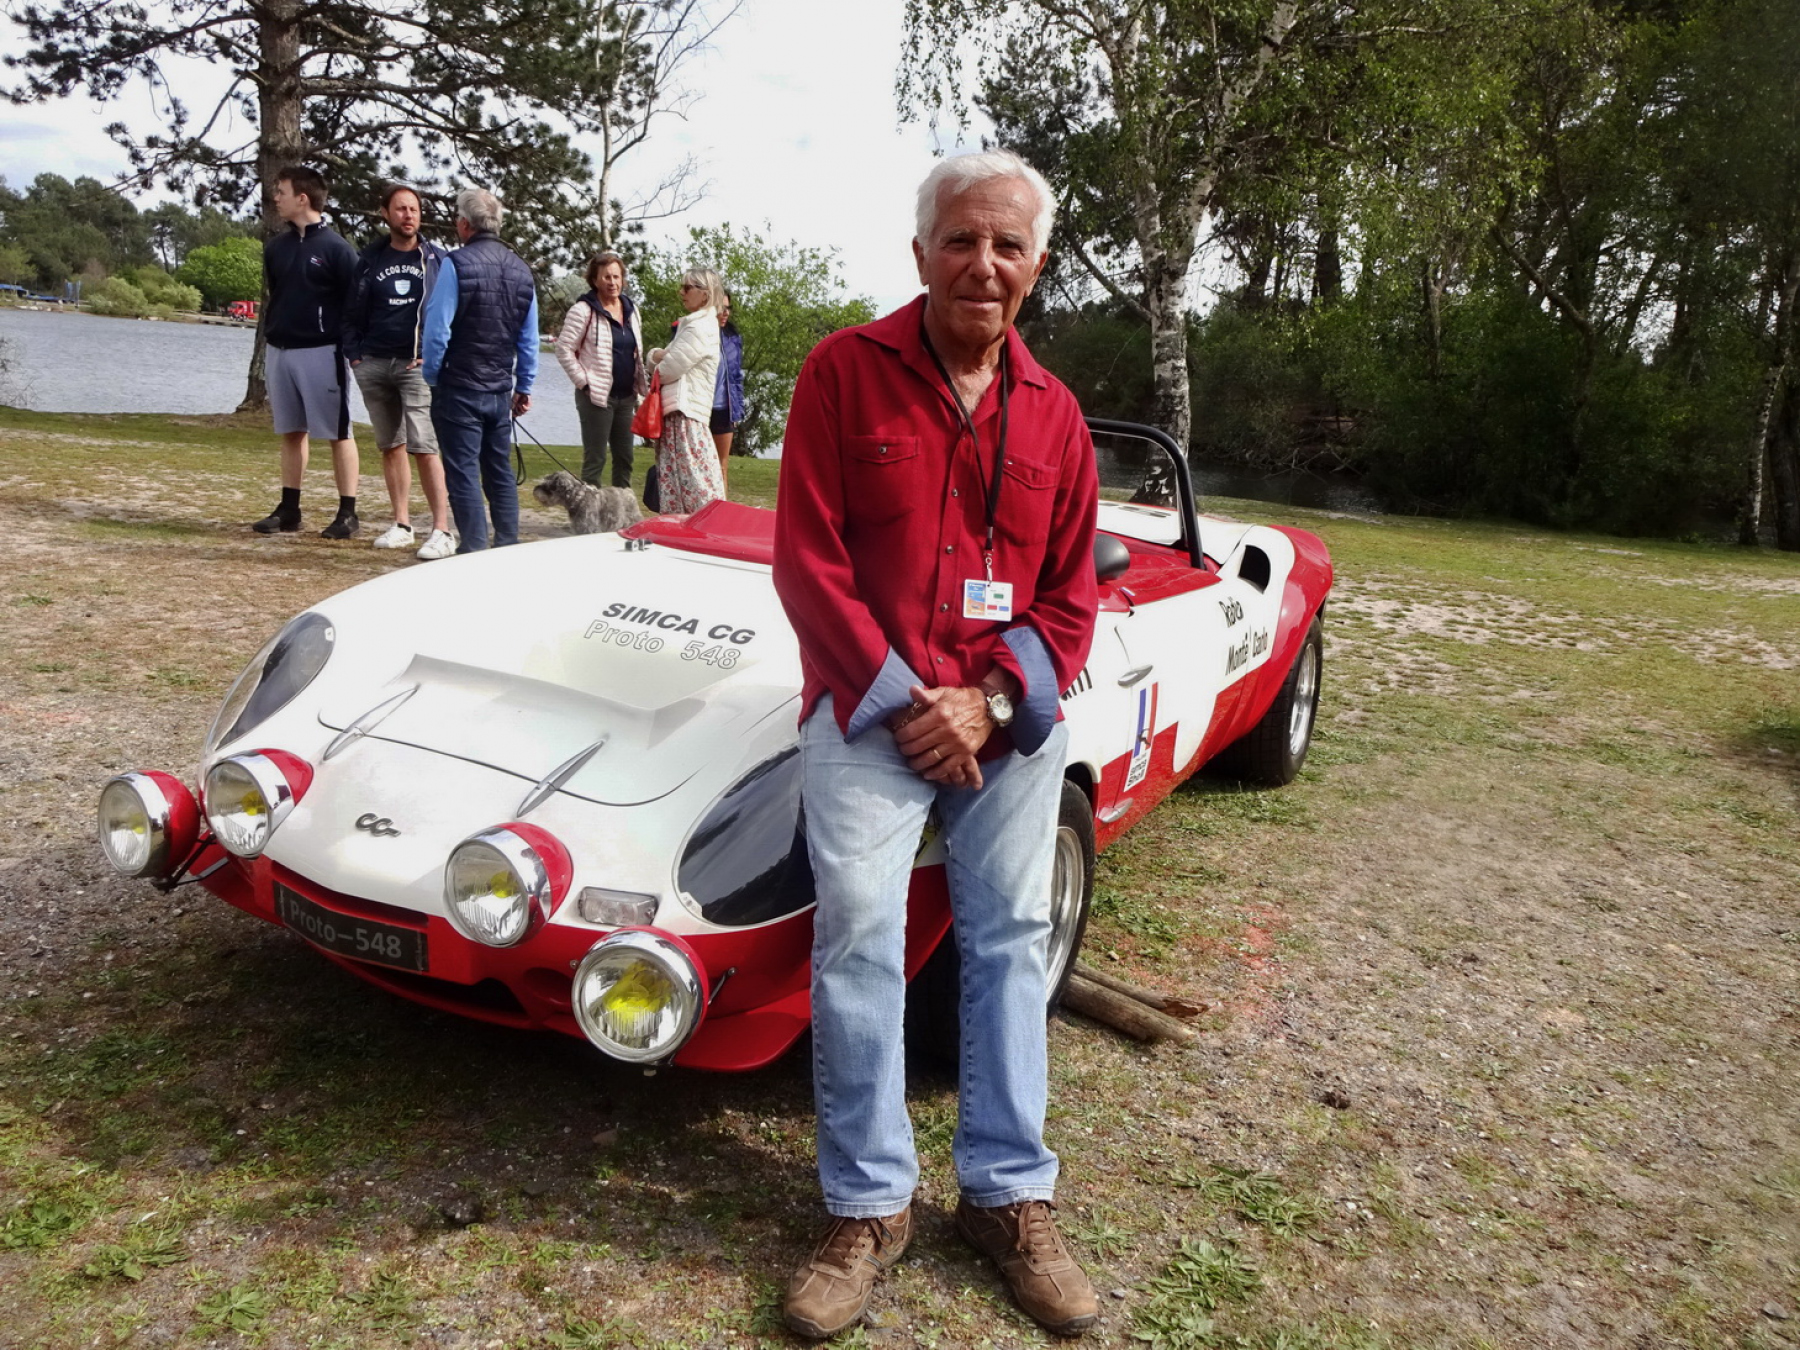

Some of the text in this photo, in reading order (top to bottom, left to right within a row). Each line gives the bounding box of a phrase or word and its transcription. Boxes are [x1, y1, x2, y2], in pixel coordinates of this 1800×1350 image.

[376, 271, 386, 281] LE
[385, 265, 401, 276] COQ
[583, 619, 741, 669] Proto 548
[602, 602, 756, 645] SIMCA CG
[289, 899, 402, 959] Proto-548
